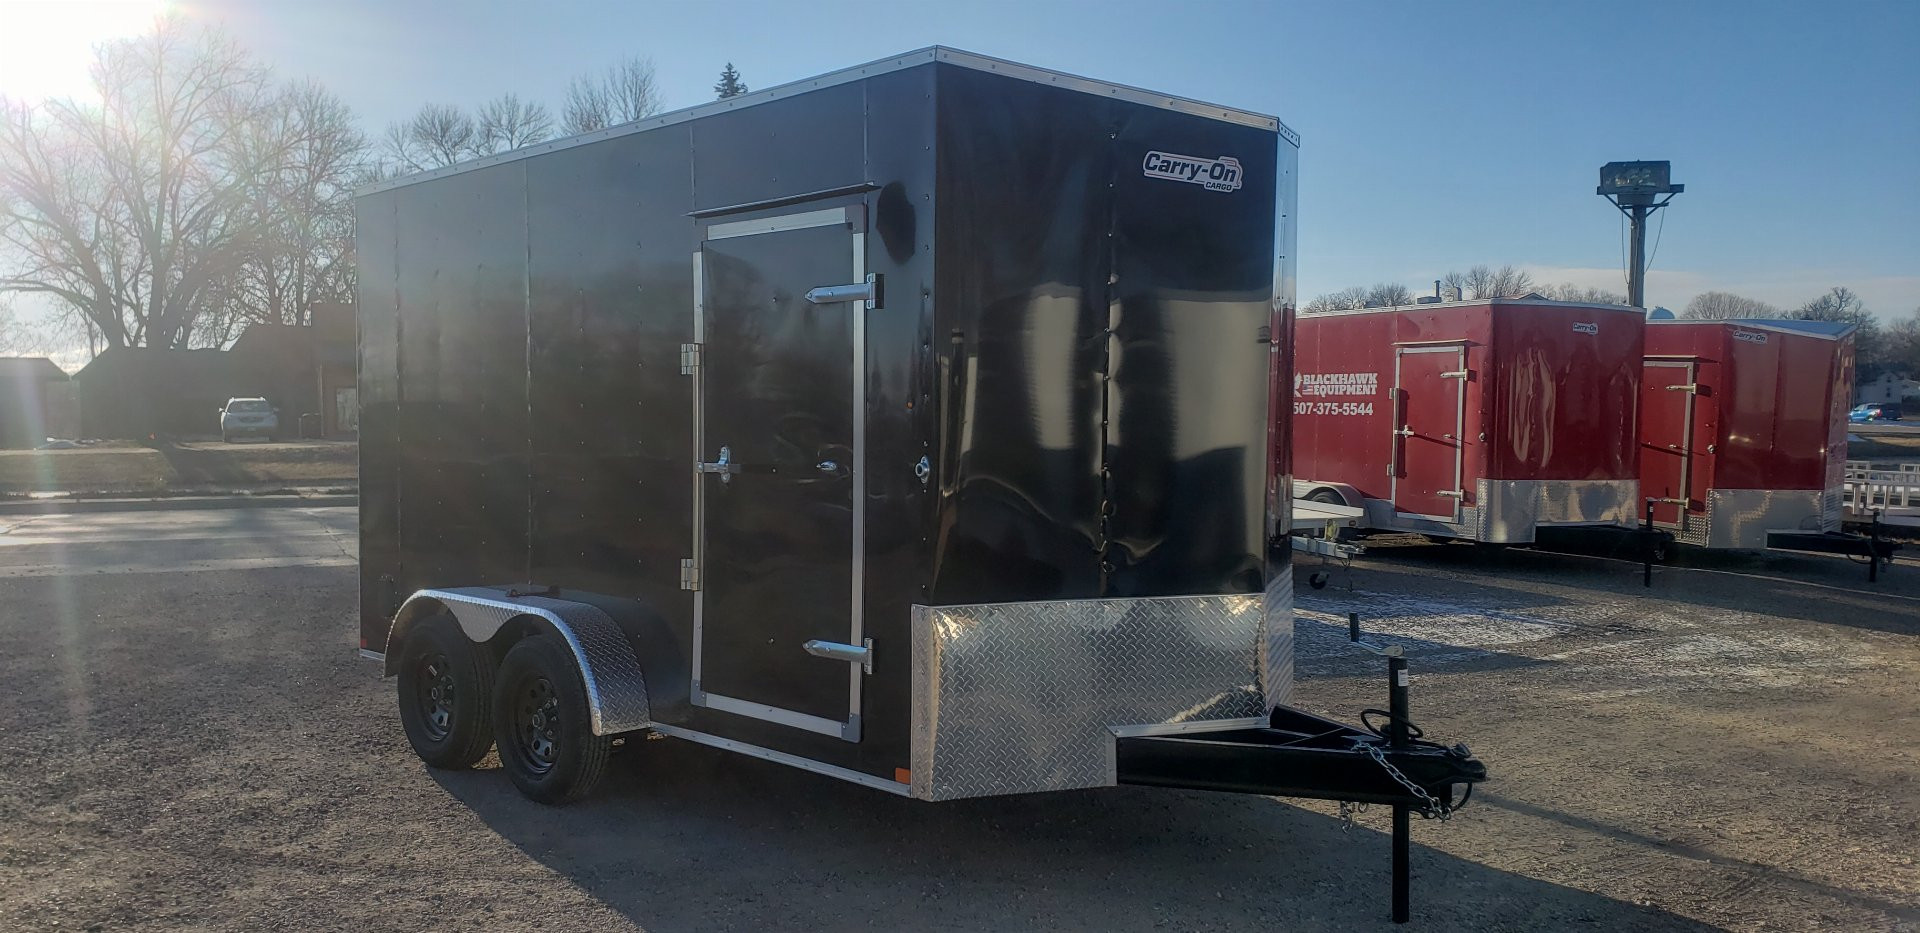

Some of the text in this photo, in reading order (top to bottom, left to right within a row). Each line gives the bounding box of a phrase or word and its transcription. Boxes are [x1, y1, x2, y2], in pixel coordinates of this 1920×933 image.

[1144, 153, 1237, 182] Carry-On
[1205, 181, 1232, 191] CARGO
[1733, 330, 1766, 342] Carry-On
[1303, 373, 1378, 384] BLACKHAWK
[1313, 384, 1377, 397] EQUIPMENT
[1293, 402, 1373, 415] 507-375-5544
